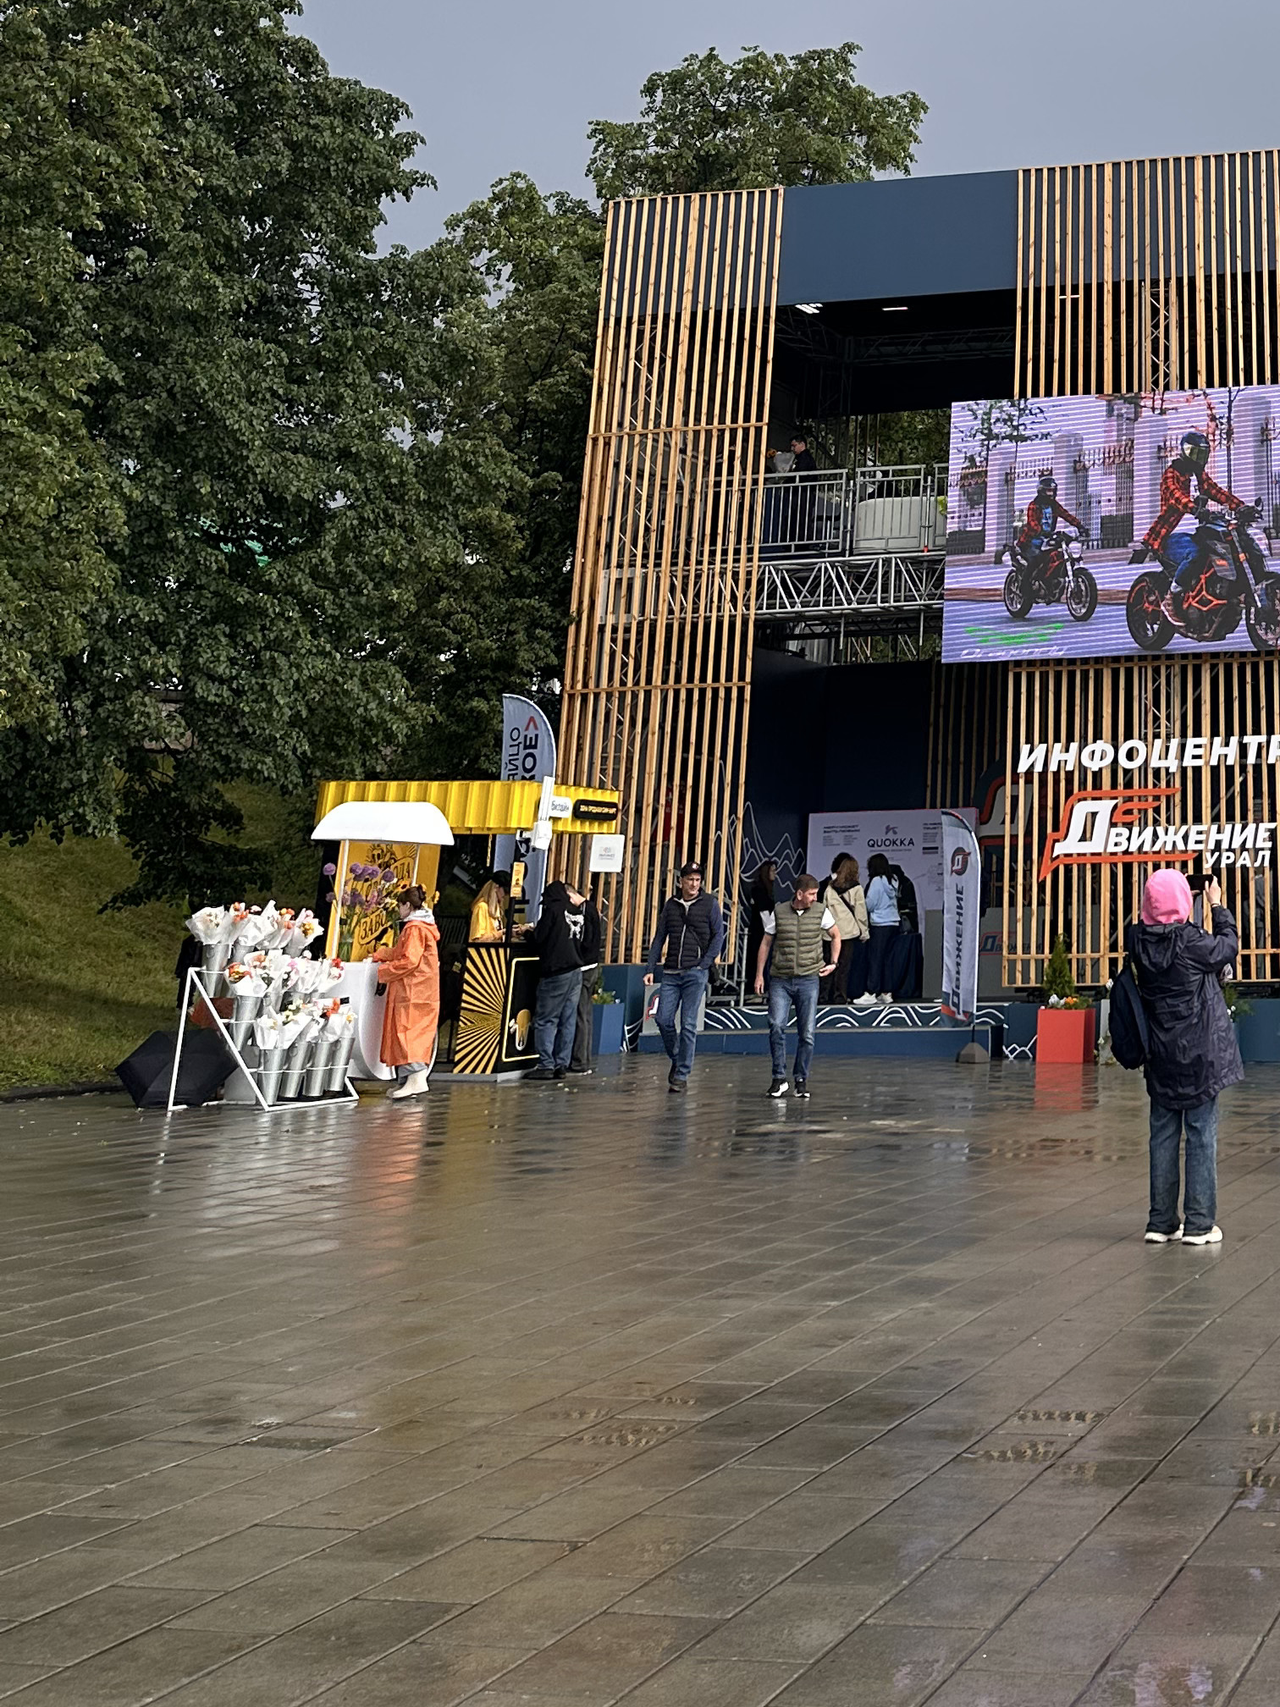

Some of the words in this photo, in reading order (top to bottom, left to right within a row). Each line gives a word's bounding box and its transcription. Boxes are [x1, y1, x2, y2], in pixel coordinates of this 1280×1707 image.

[1054, 799, 1278, 857] ДВИЖЕНИЕ
[867, 837, 915, 848] QUOKKA
[1204, 849, 1271, 869] УРАЛ
